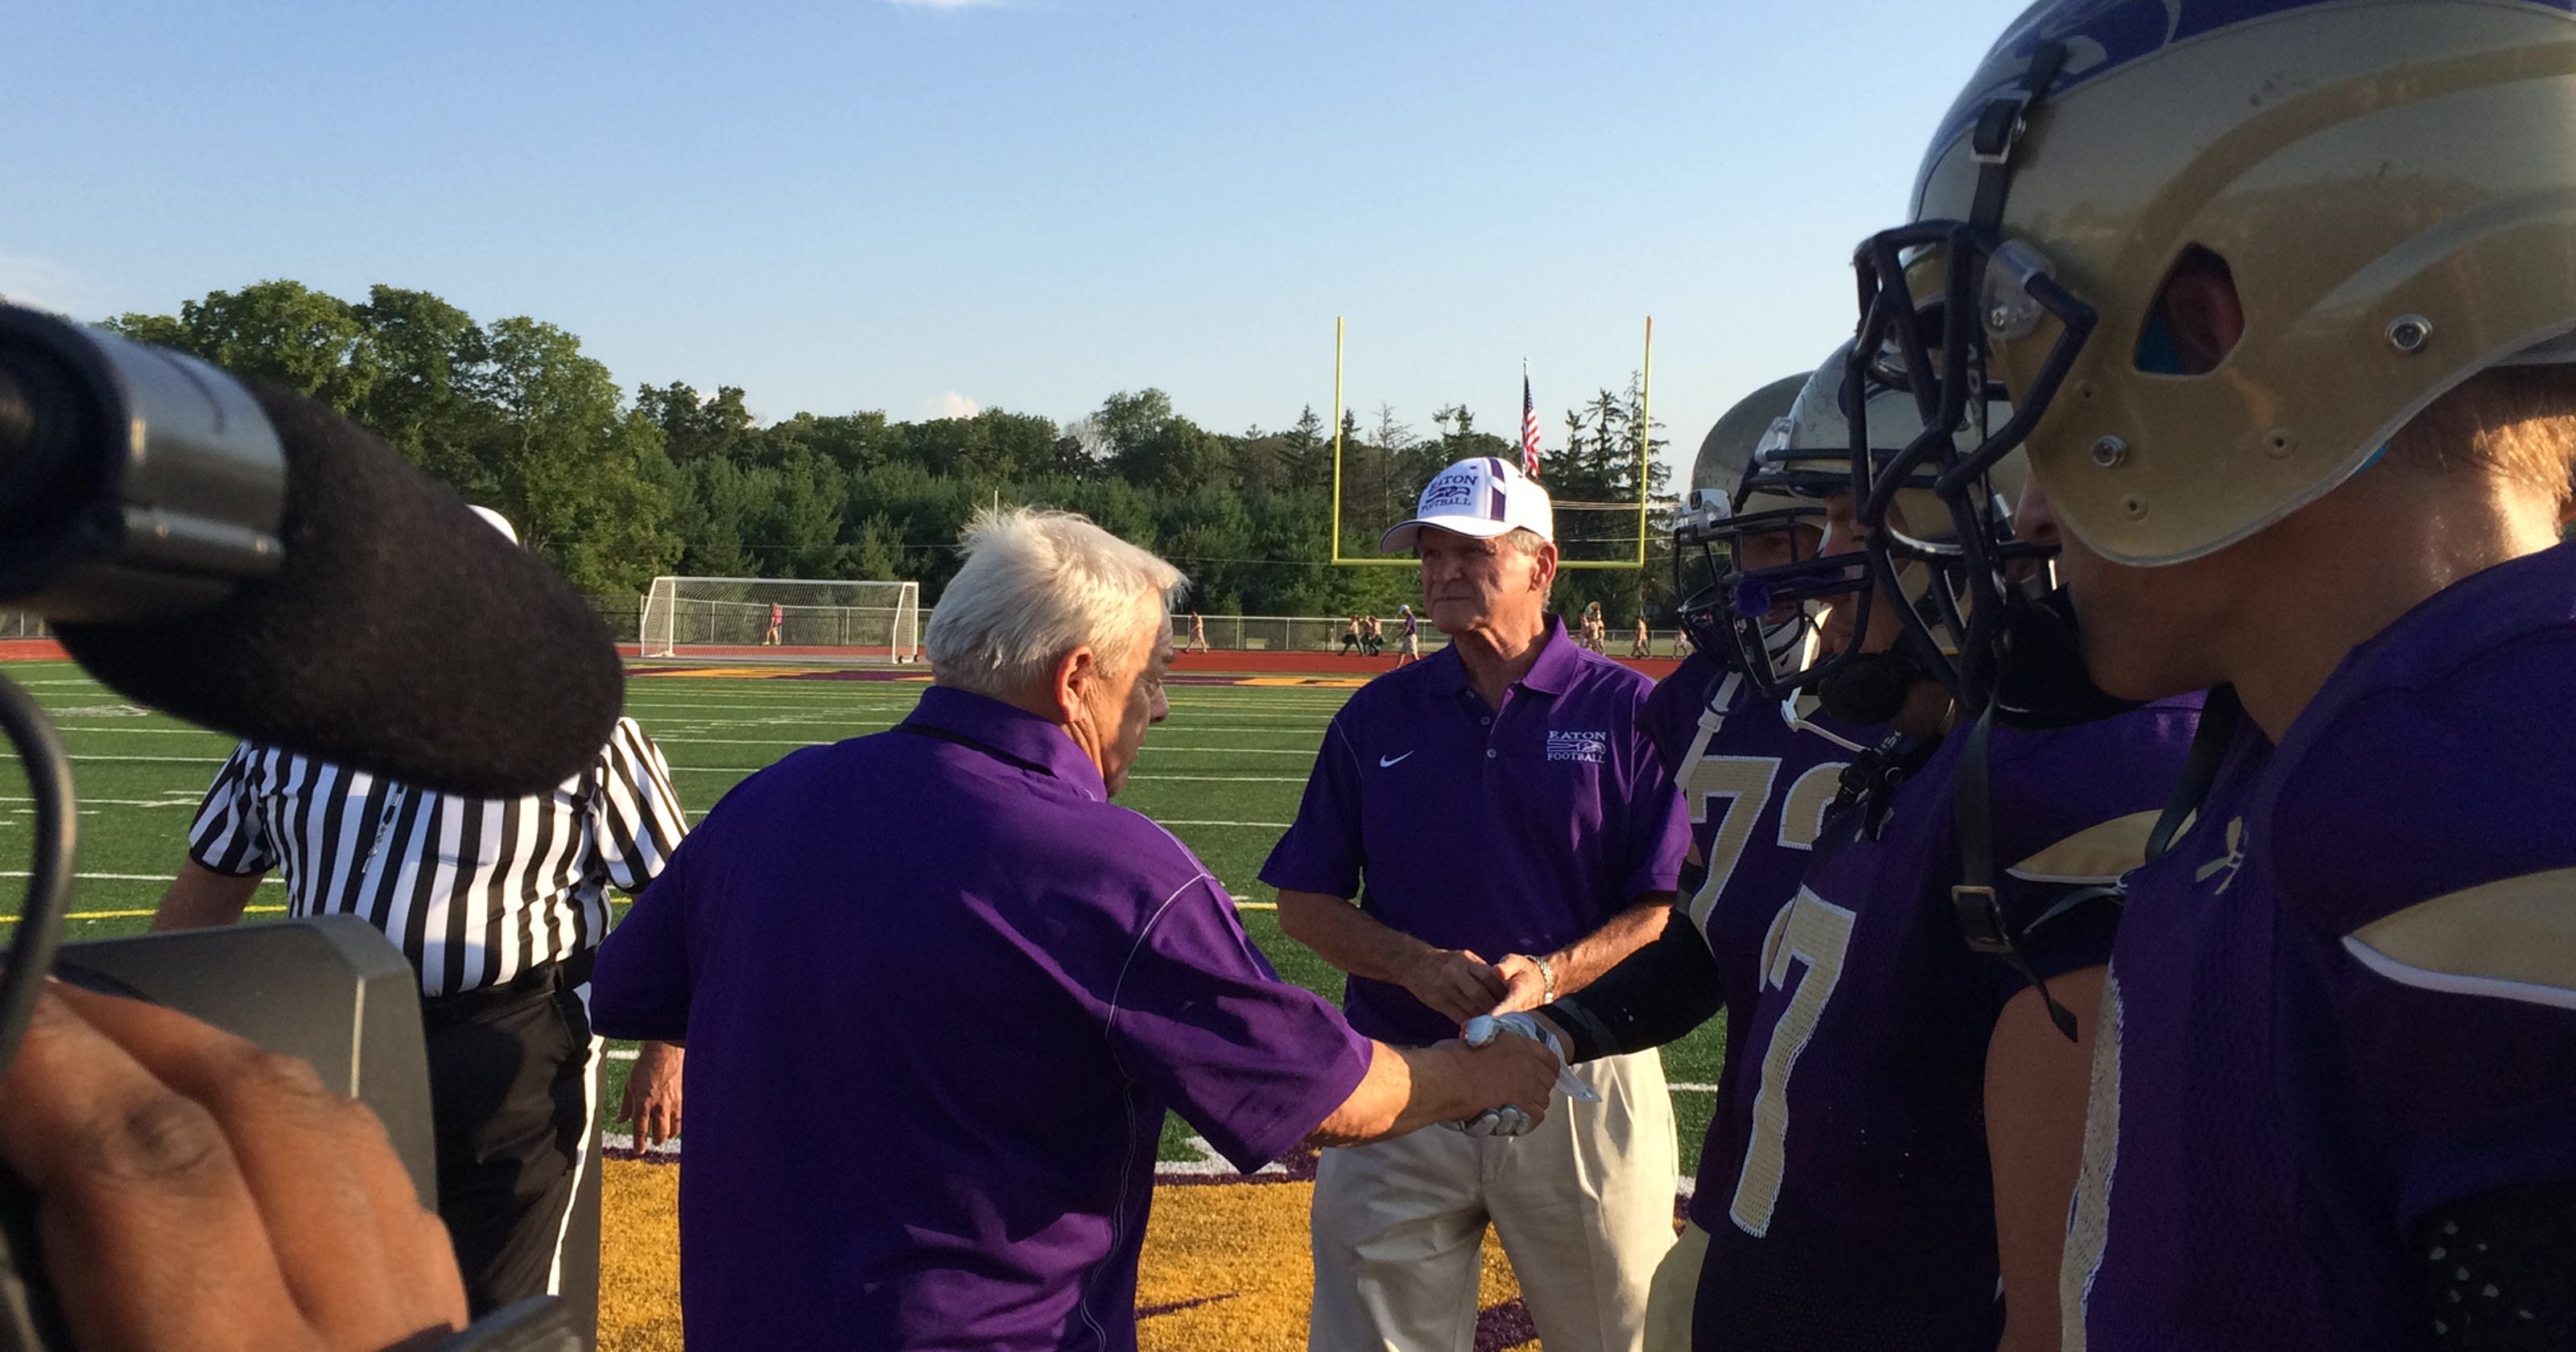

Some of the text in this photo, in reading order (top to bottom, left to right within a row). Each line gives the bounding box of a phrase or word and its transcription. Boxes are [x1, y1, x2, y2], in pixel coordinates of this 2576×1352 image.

[1548, 730, 1606, 740] EATON
[1546, 752, 1605, 764] FOOTBALL
[1728, 884, 1857, 1239] 7
